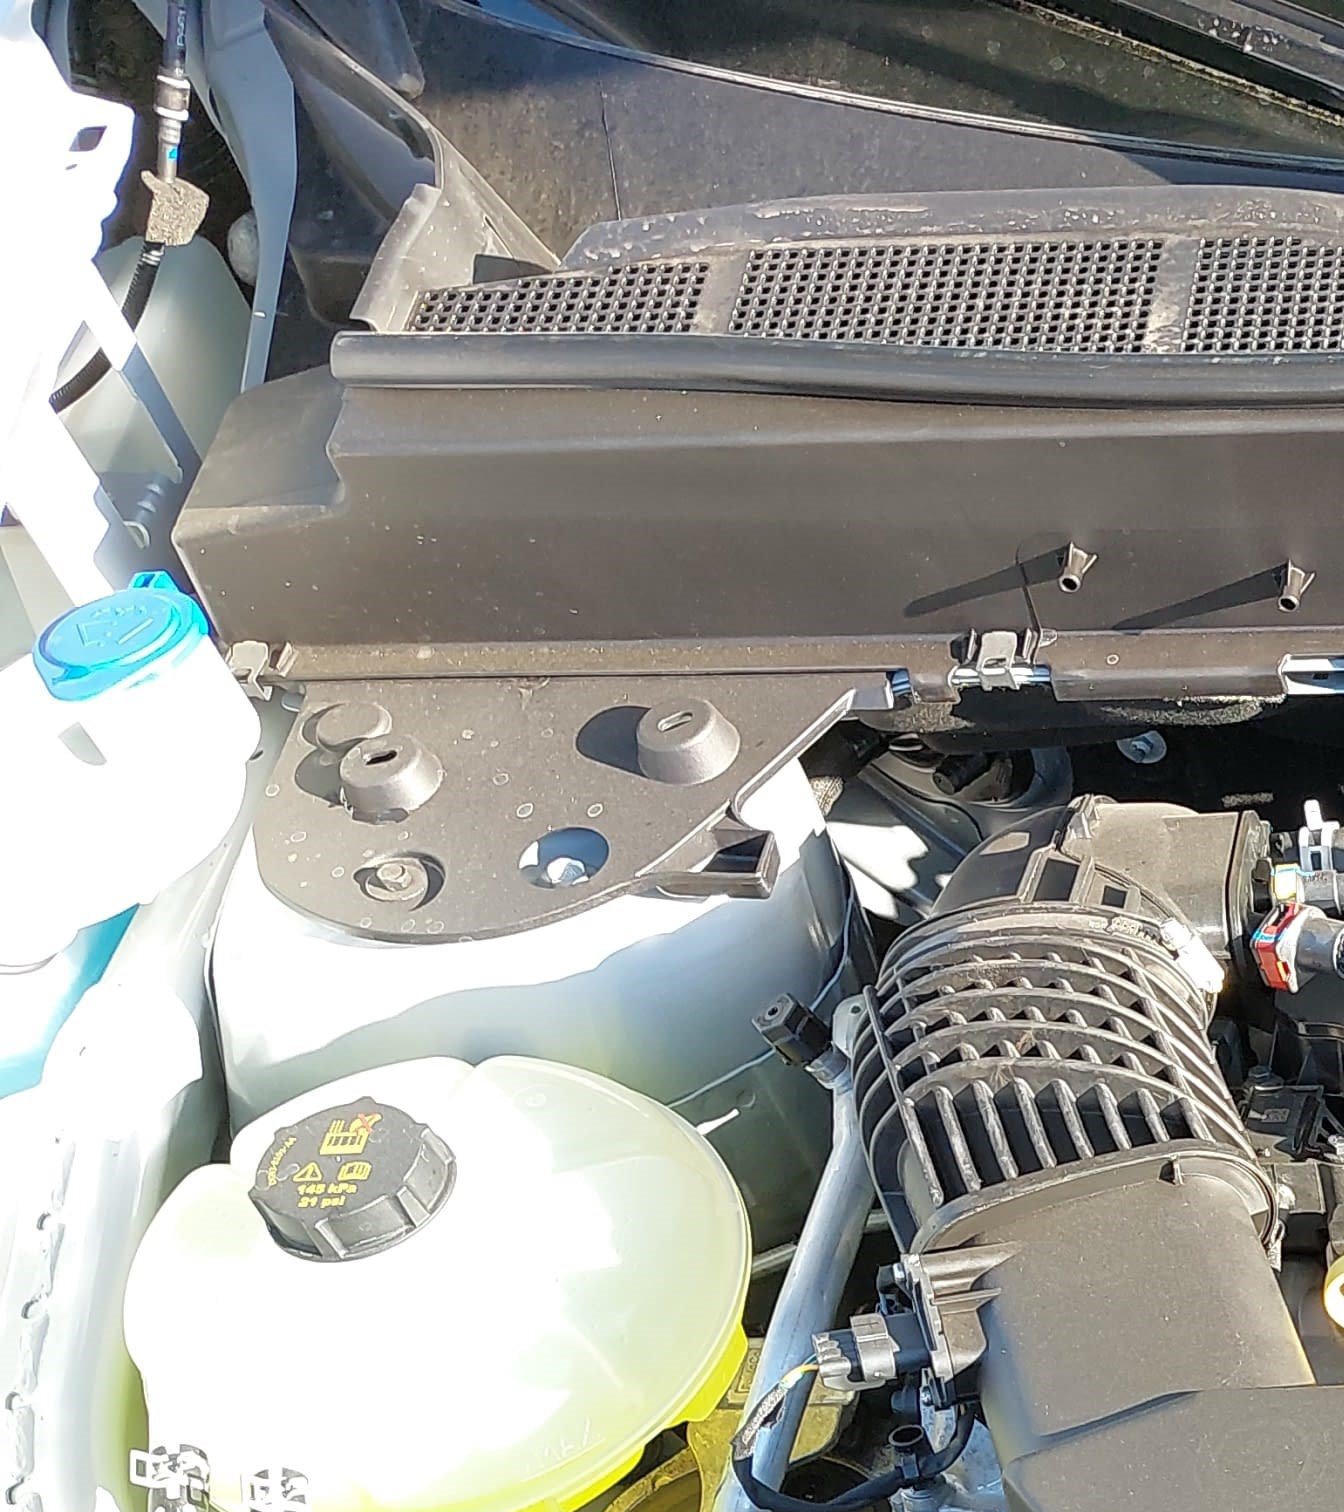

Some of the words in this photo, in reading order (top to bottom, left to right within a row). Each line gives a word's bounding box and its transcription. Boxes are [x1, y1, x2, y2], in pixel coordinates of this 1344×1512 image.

[297, 1183, 326, 1198] 145
[327, 1182, 358, 1197] kPa
[297, 1195, 319, 1209] 21
[319, 1195, 346, 1210] psi
